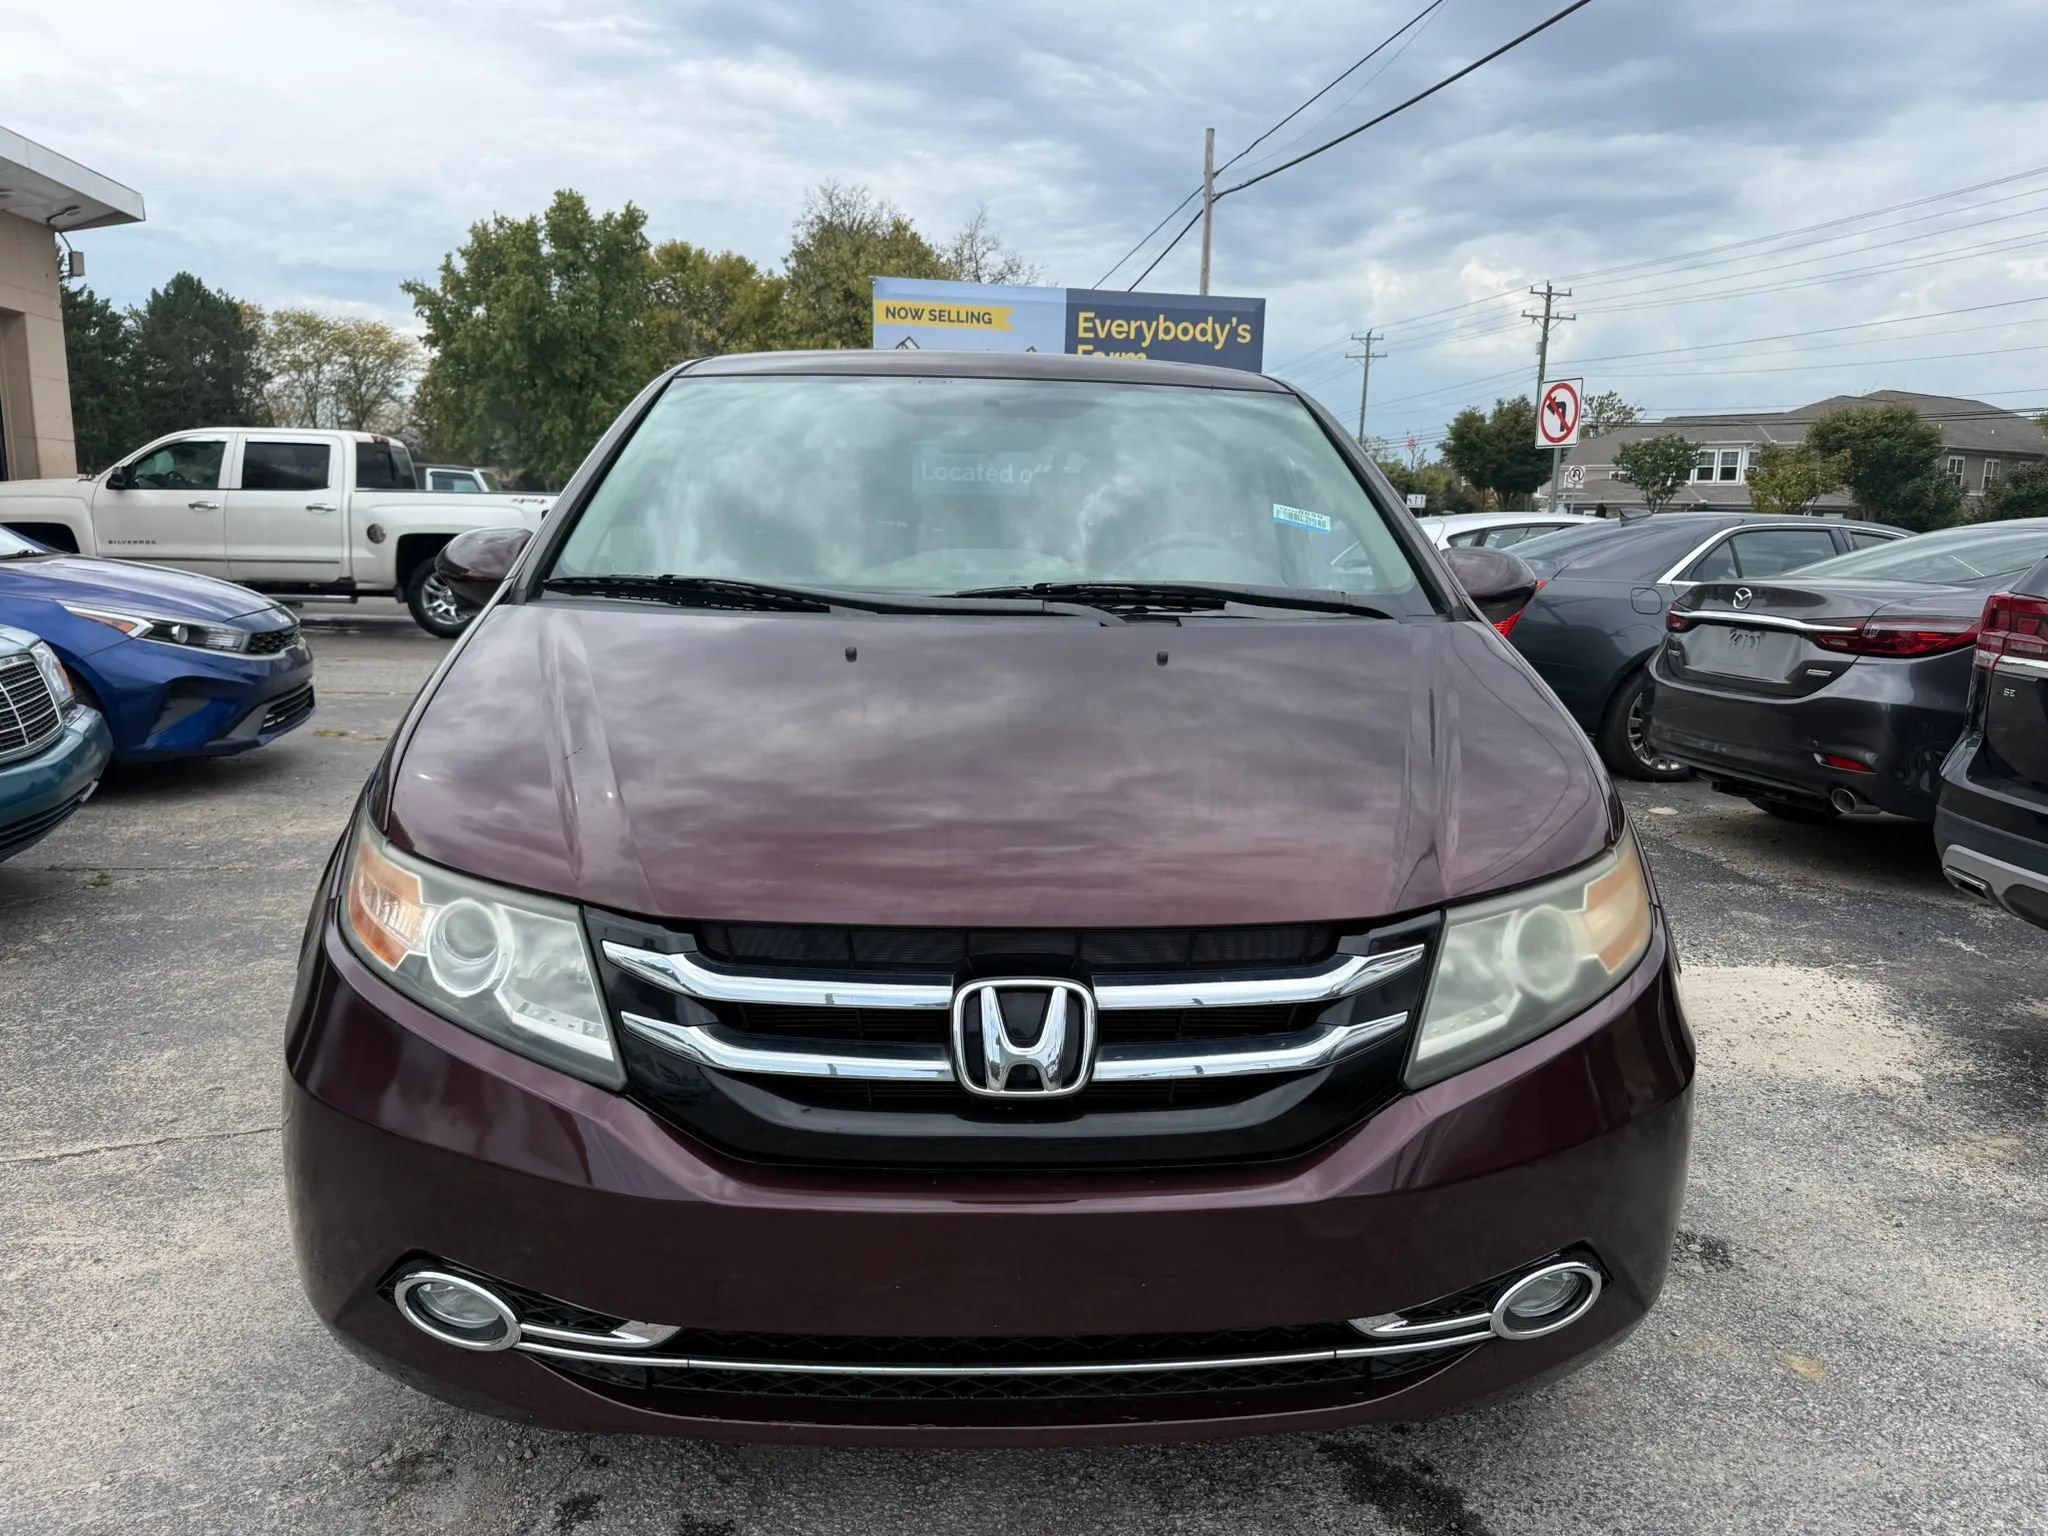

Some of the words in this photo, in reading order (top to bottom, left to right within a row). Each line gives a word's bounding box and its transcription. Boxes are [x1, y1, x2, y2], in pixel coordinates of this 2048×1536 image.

[885, 306, 925, 321] NOW
[928, 309, 993, 325] SELLING
[1077, 311, 1252, 351] Everybody's
[921, 461, 1014, 483] Located
